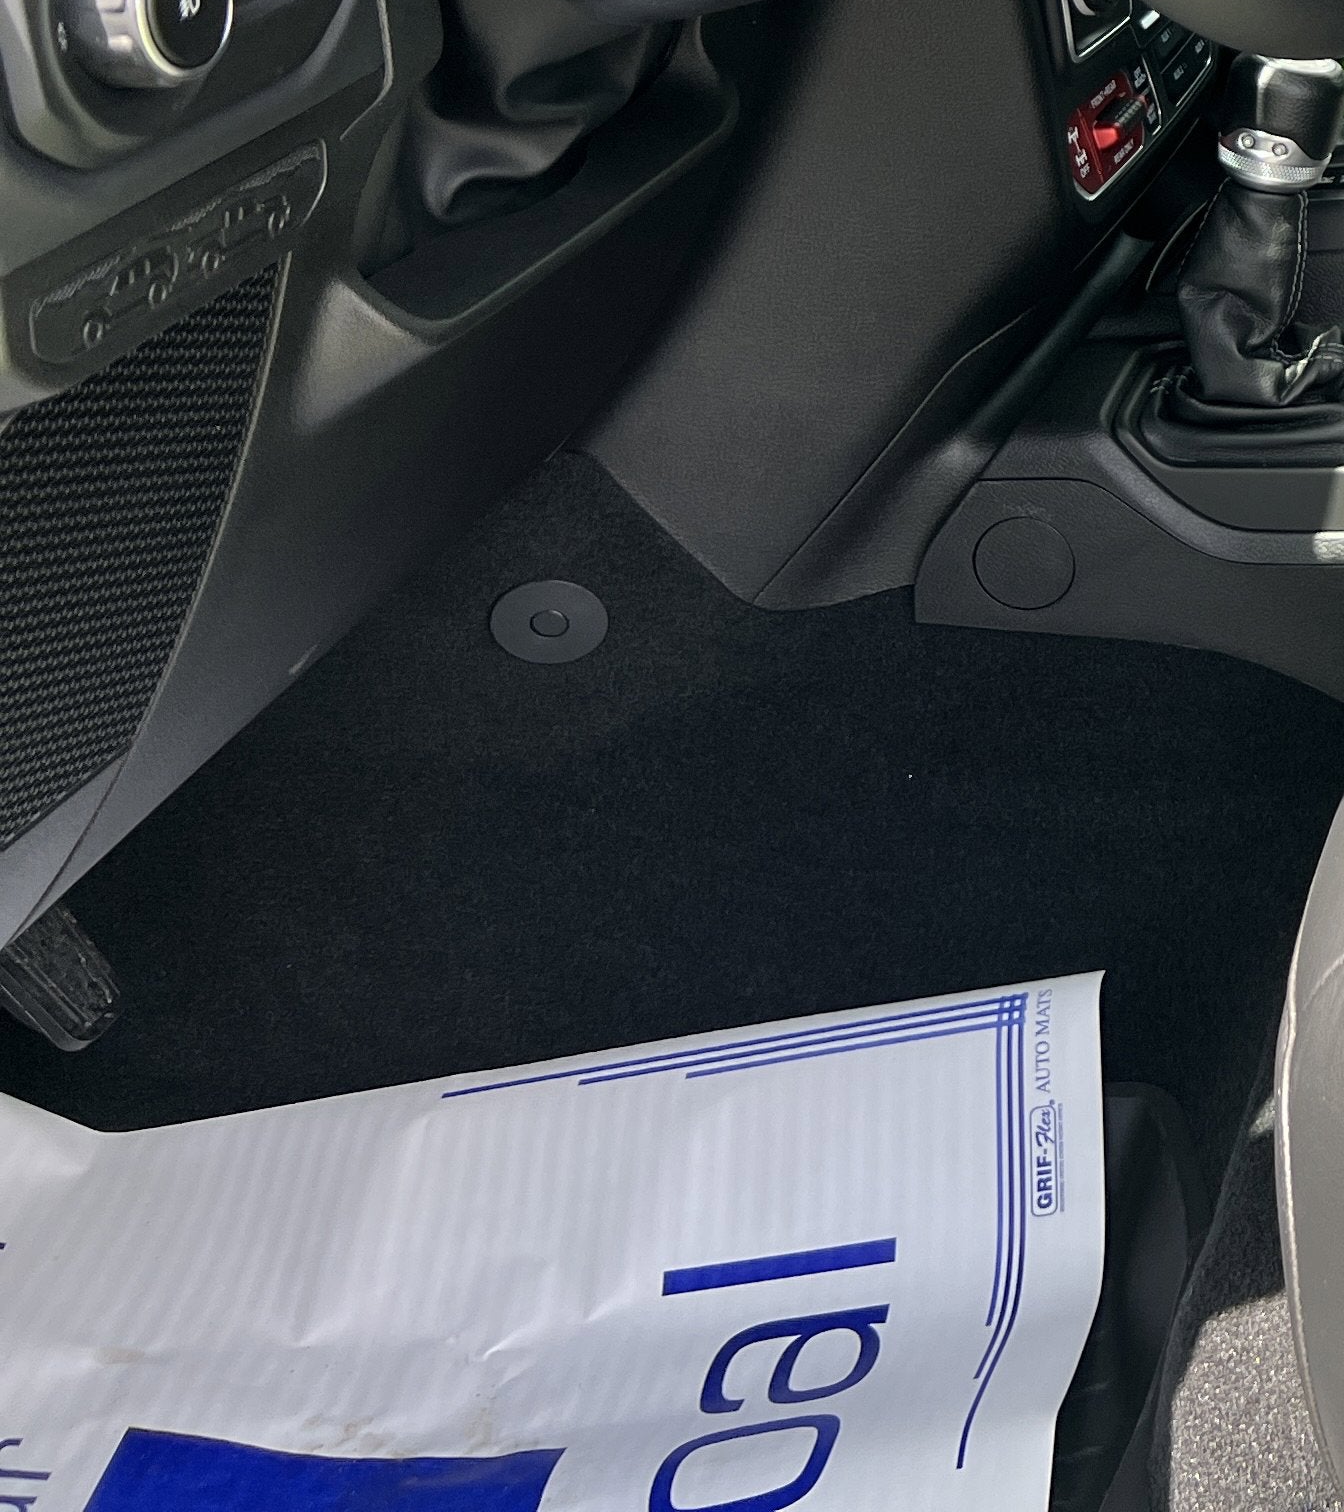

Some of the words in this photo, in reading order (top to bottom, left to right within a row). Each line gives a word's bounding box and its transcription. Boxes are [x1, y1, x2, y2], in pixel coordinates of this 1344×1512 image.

[1035, 988, 1053, 1037] MATS
[1035, 1040, 1051, 1094] AUTO
[1035, 1107, 1055, 1210] GRIF-Flex
